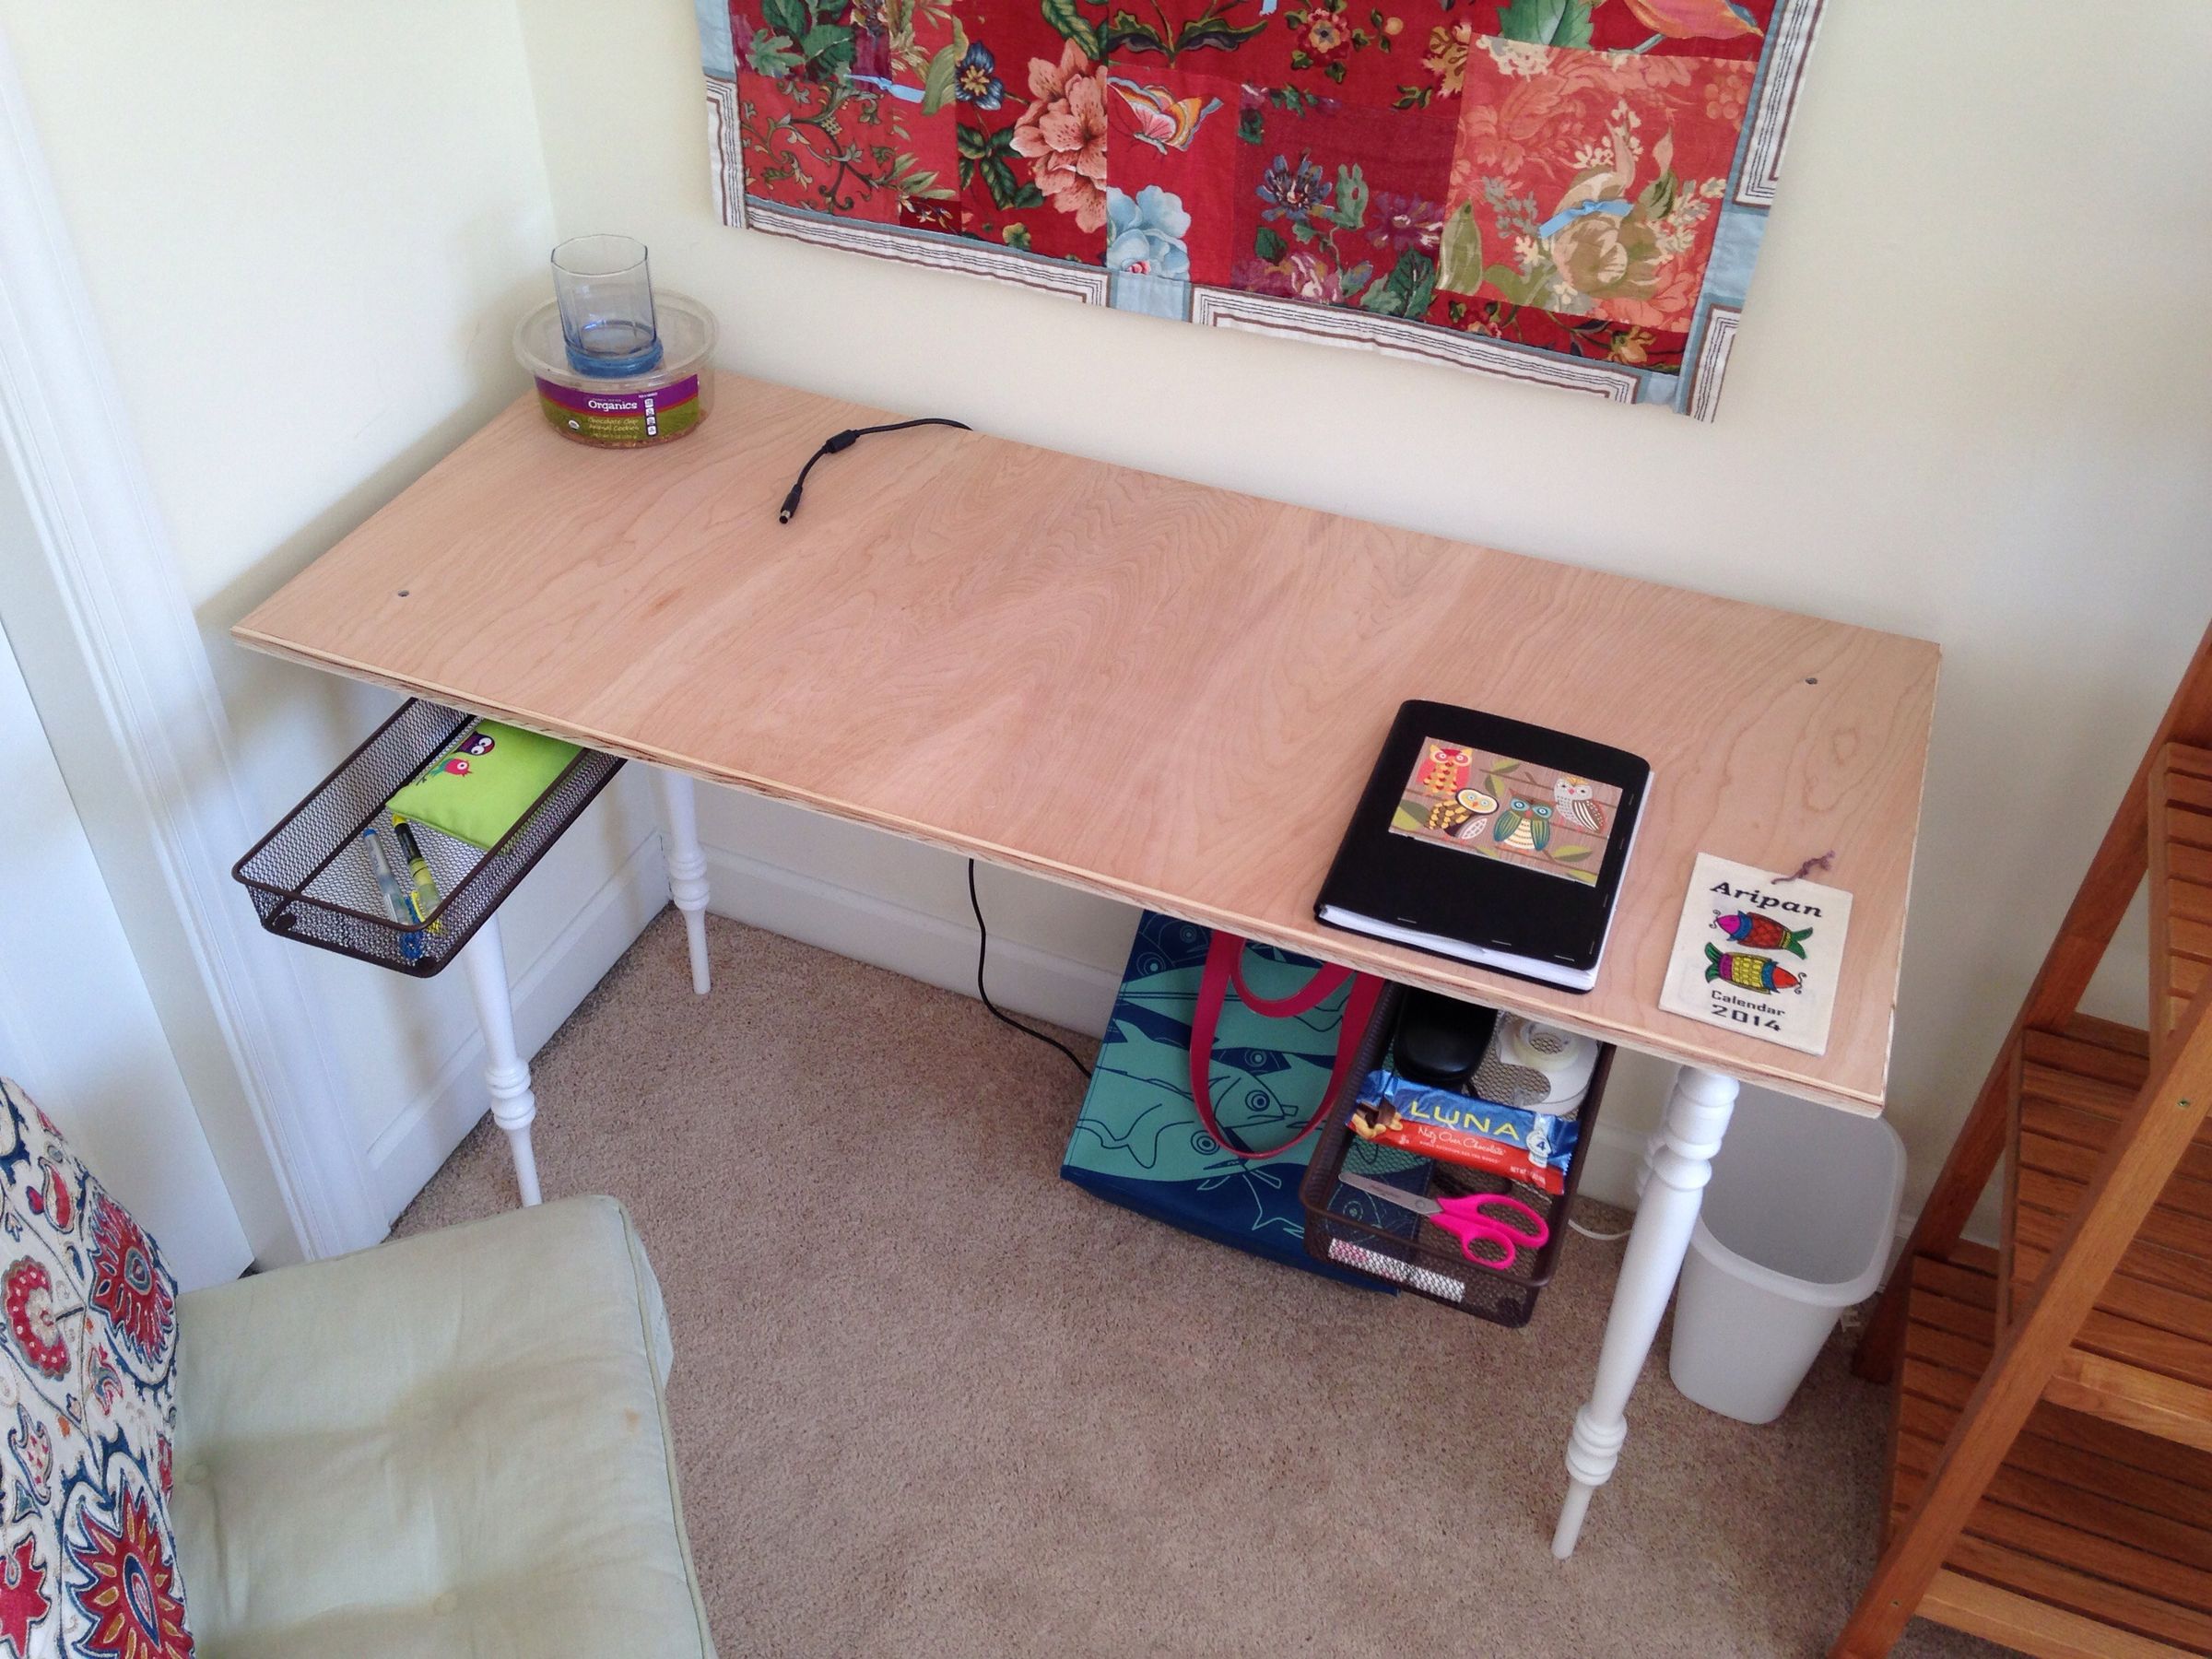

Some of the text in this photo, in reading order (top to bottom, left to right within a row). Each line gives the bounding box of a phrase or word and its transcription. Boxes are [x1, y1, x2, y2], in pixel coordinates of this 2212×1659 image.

[588, 400, 638, 412] Organics
[1710, 881, 1822, 918] Aripan
[1712, 990, 1786, 1017] Calendar
[1712, 1004, 1782, 1032] 2014
[1410, 1100, 1520, 1141] LUNA
[1439, 1132, 1462, 1146] Over
[1463, 1137, 1505, 1156] Chocolate
[1536, 1141, 1546, 1151] 4
